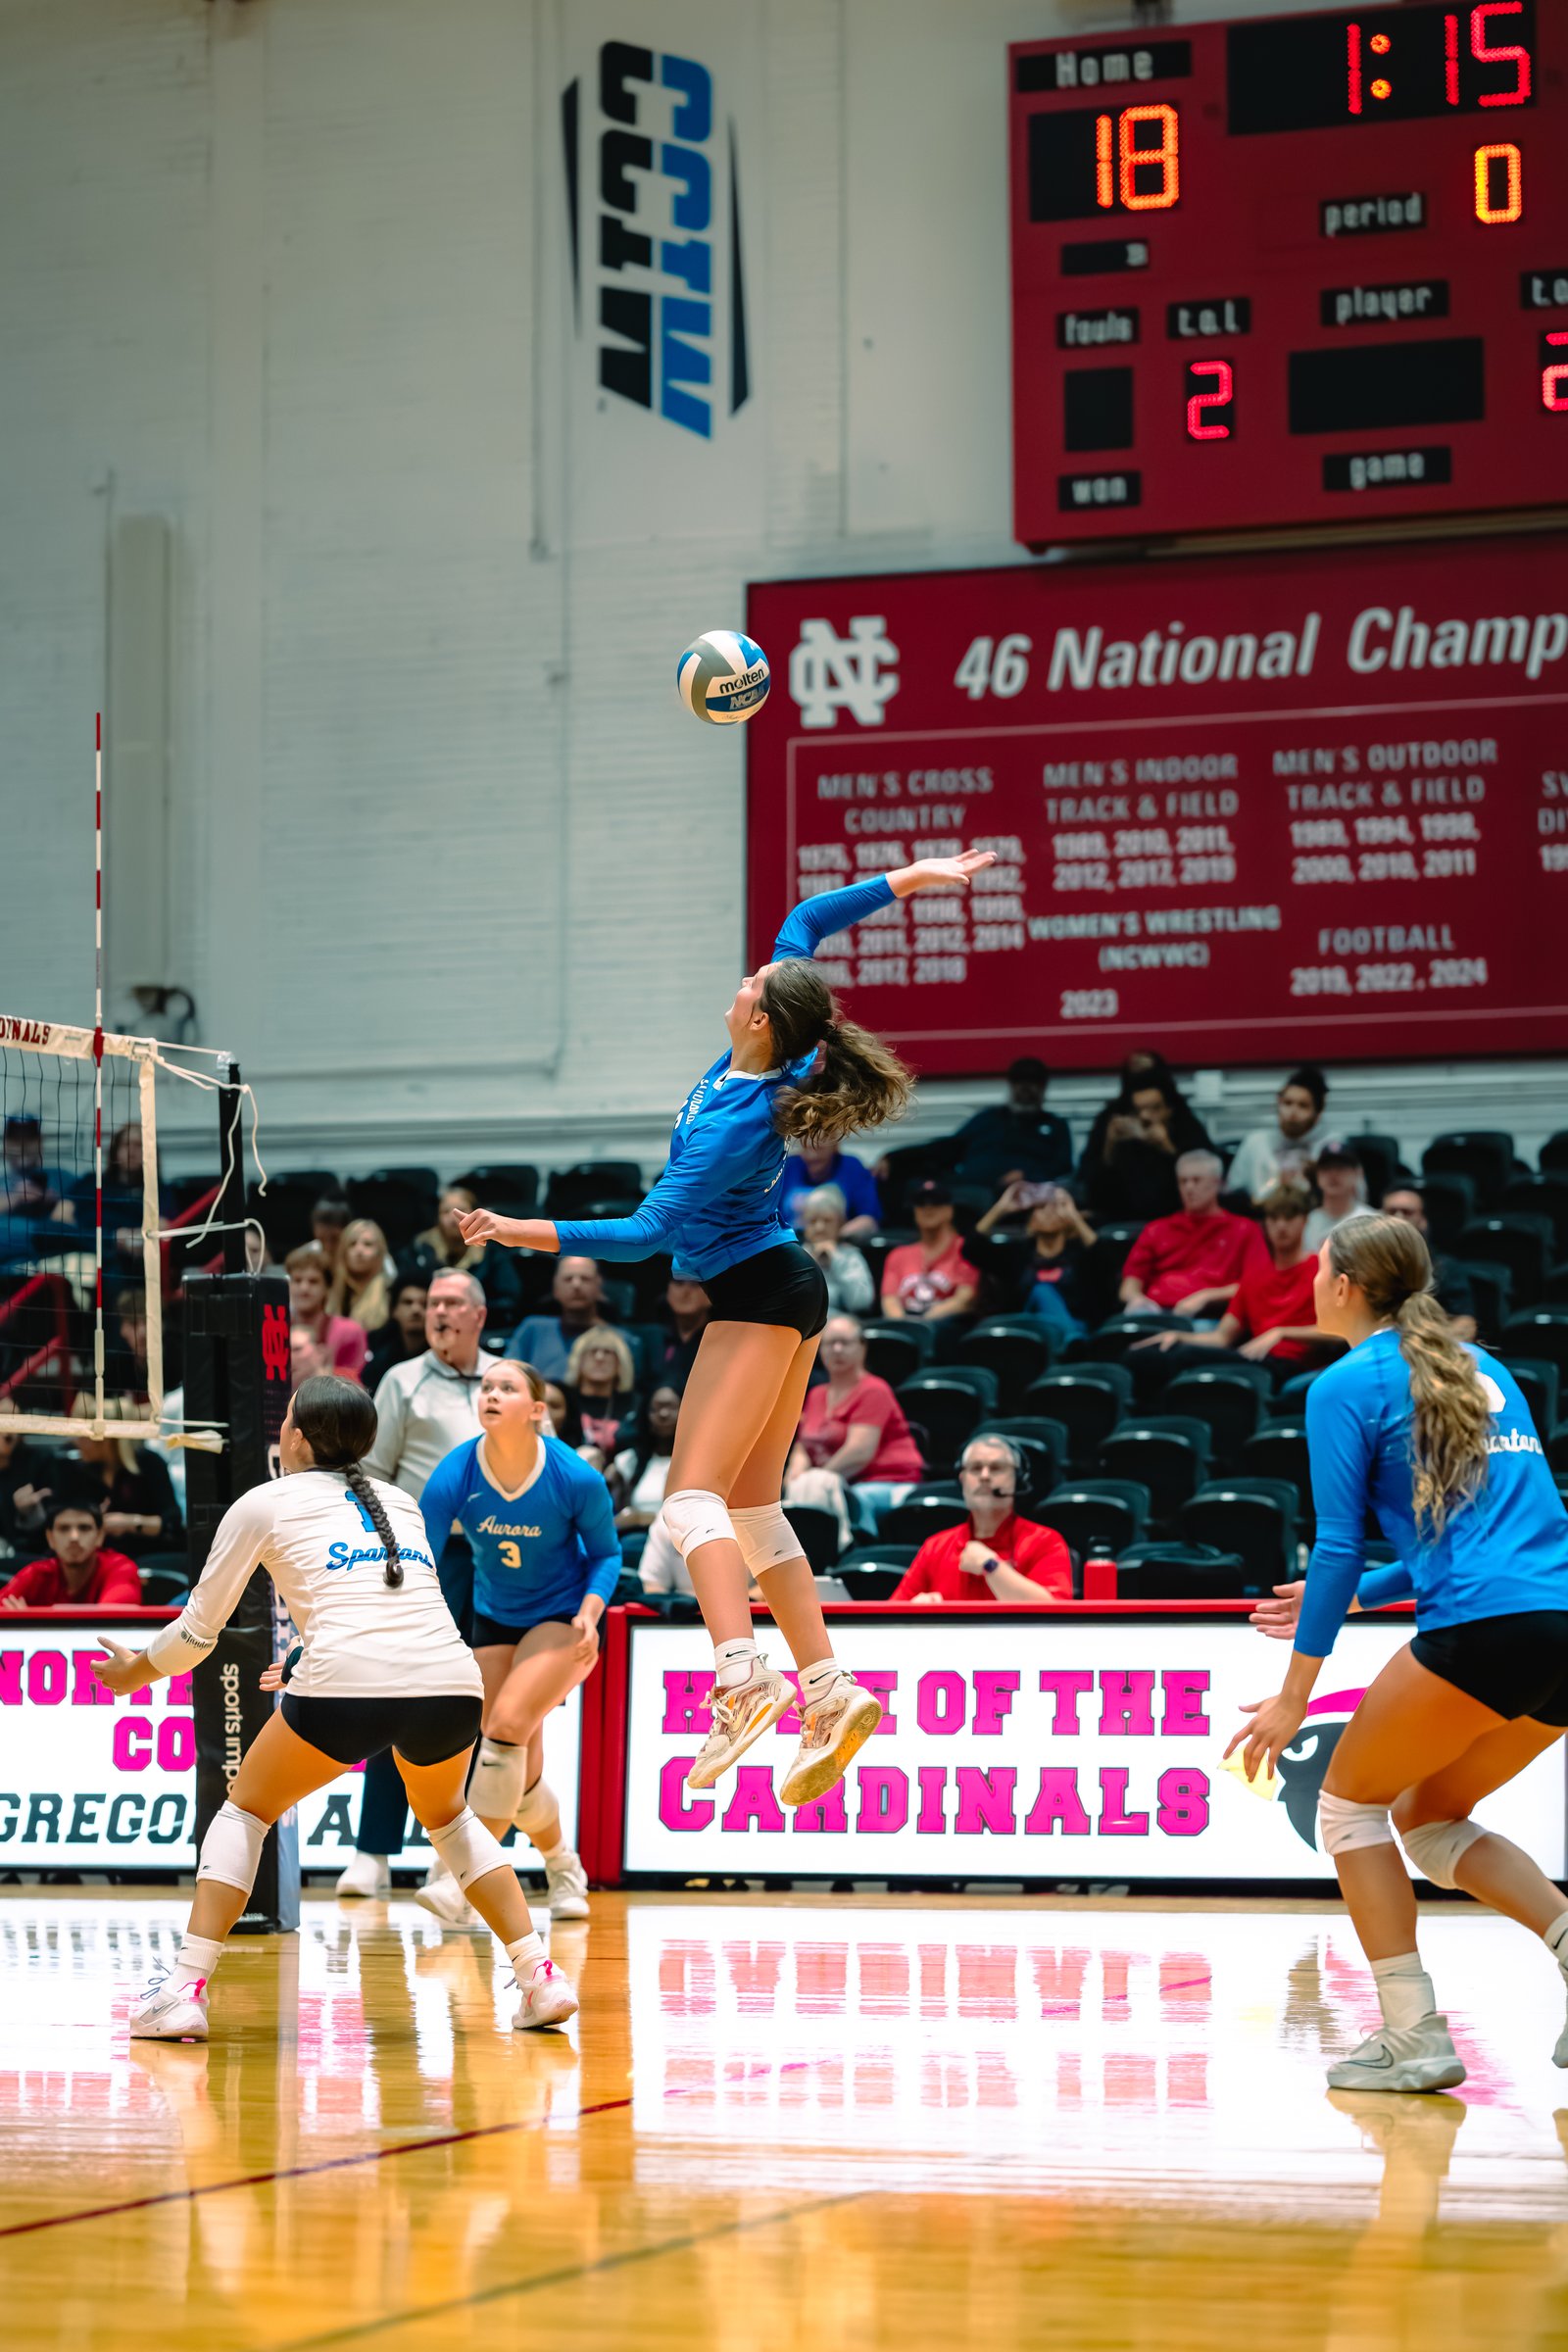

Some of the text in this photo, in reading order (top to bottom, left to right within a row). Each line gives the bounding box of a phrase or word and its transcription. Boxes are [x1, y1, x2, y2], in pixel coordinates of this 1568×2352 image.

[1054, 50, 1153, 88] Home
[1347, 1, 1531, 115] 1:15
[1096, 104, 1180, 211] 18
[1475, 143, 1522, 224] 0
[1325, 192, 1422, 237] period
[1336, 285, 1434, 325] player
[1187, 361, 1233, 440] 2
[1349, 452, 1426, 490] game
[1072, 476, 1127, 505] won
[954, 606, 1568, 700] 46 National Champ
[719, 668, 764, 694] molten
[1044, 754, 1239, 788] MEN'S INDOOR
[1273, 738, 1498, 775] MEN'S OUTDOOR
[817, 765, 994, 799] MEN'S CROSS
[1287, 775, 1485, 810] TRACK & FIELD
[844, 804, 966, 834] COUNTRY
[1046, 789, 1239, 823] TRACK & FIELD
[1423, 848, 1477, 878] 2011
[1028, 905, 1282, 940] WOMEN'S WRESTLING
[1318, 924, 1457, 956] FOOTBALL
[1060, 988, 1119, 1019] 2023
[476, 1515, 542, 1538] Aurora
[498, 1541, 521, 1569] 3
[219, 1663, 243, 1734] sports
[917, 1670, 1020, 1736] OF
[1040, 1670, 1211, 1737] THE
